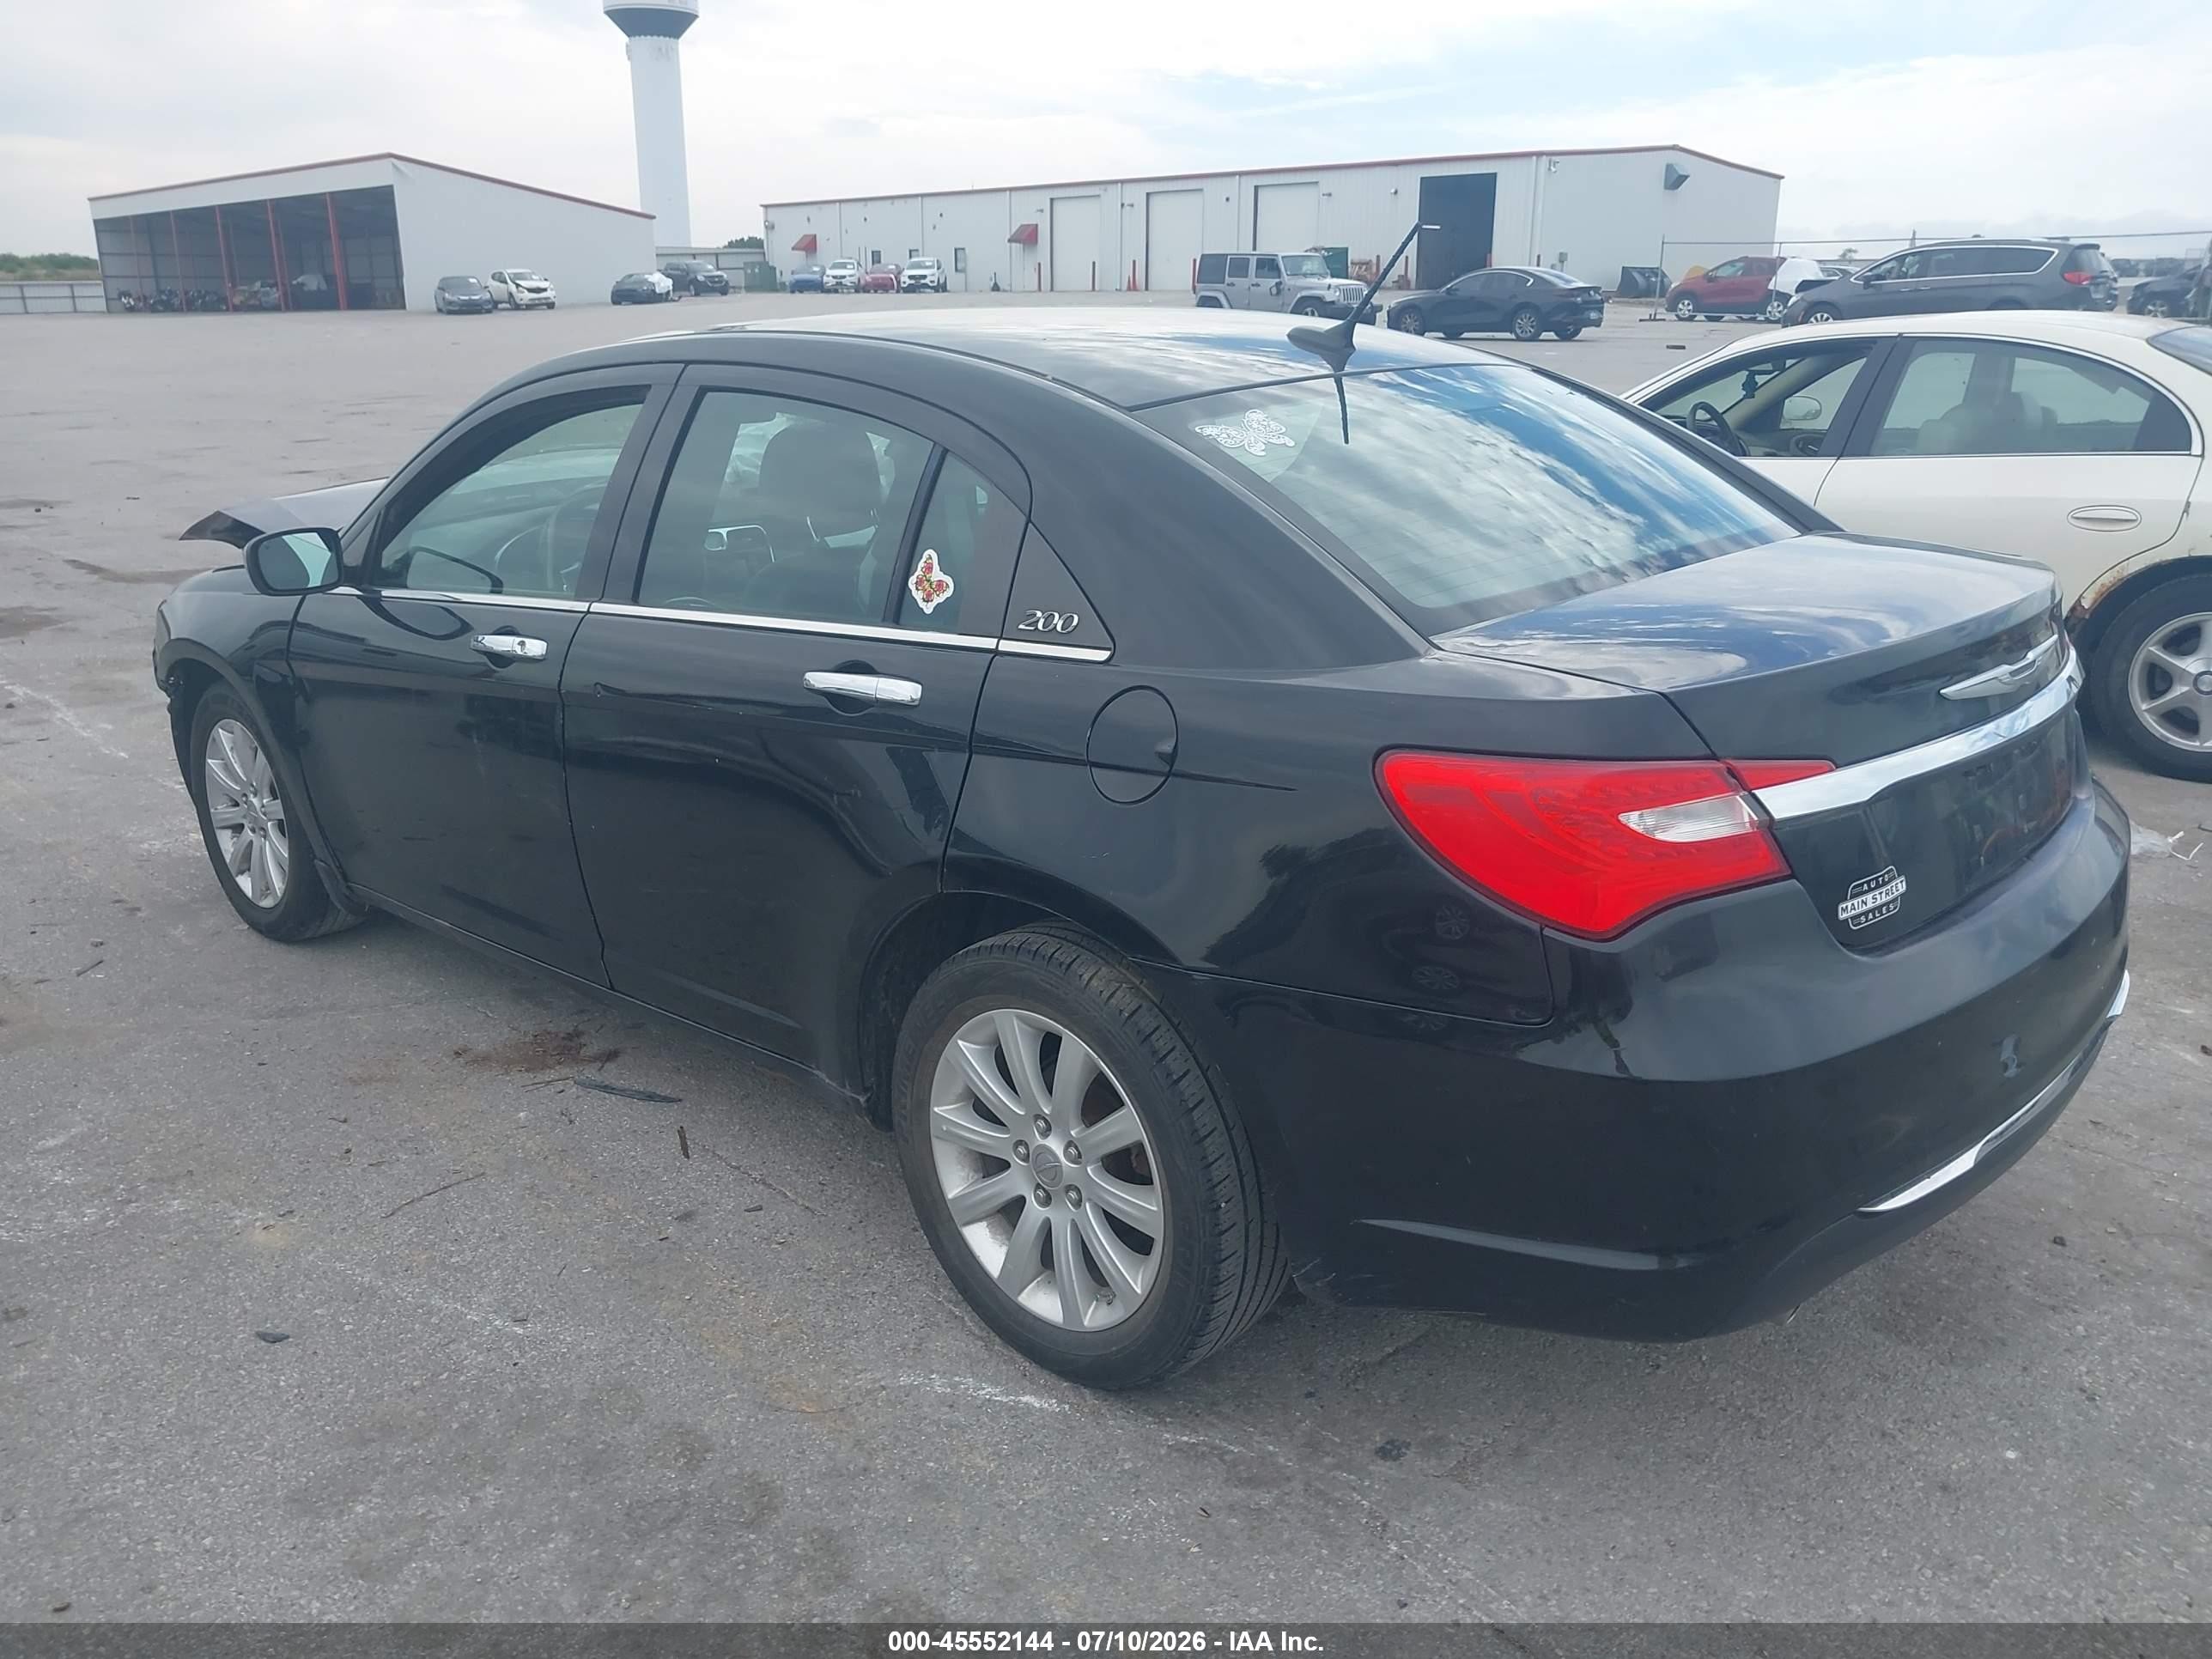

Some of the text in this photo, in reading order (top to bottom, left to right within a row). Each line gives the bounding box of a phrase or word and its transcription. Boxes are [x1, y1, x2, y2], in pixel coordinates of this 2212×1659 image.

[1018, 610, 1079, 634] 200
[1863, 874, 1888, 891] AUTO
[1840, 879, 1905, 916] MAIN STREET
[1860, 903, 1894, 923] SALES
